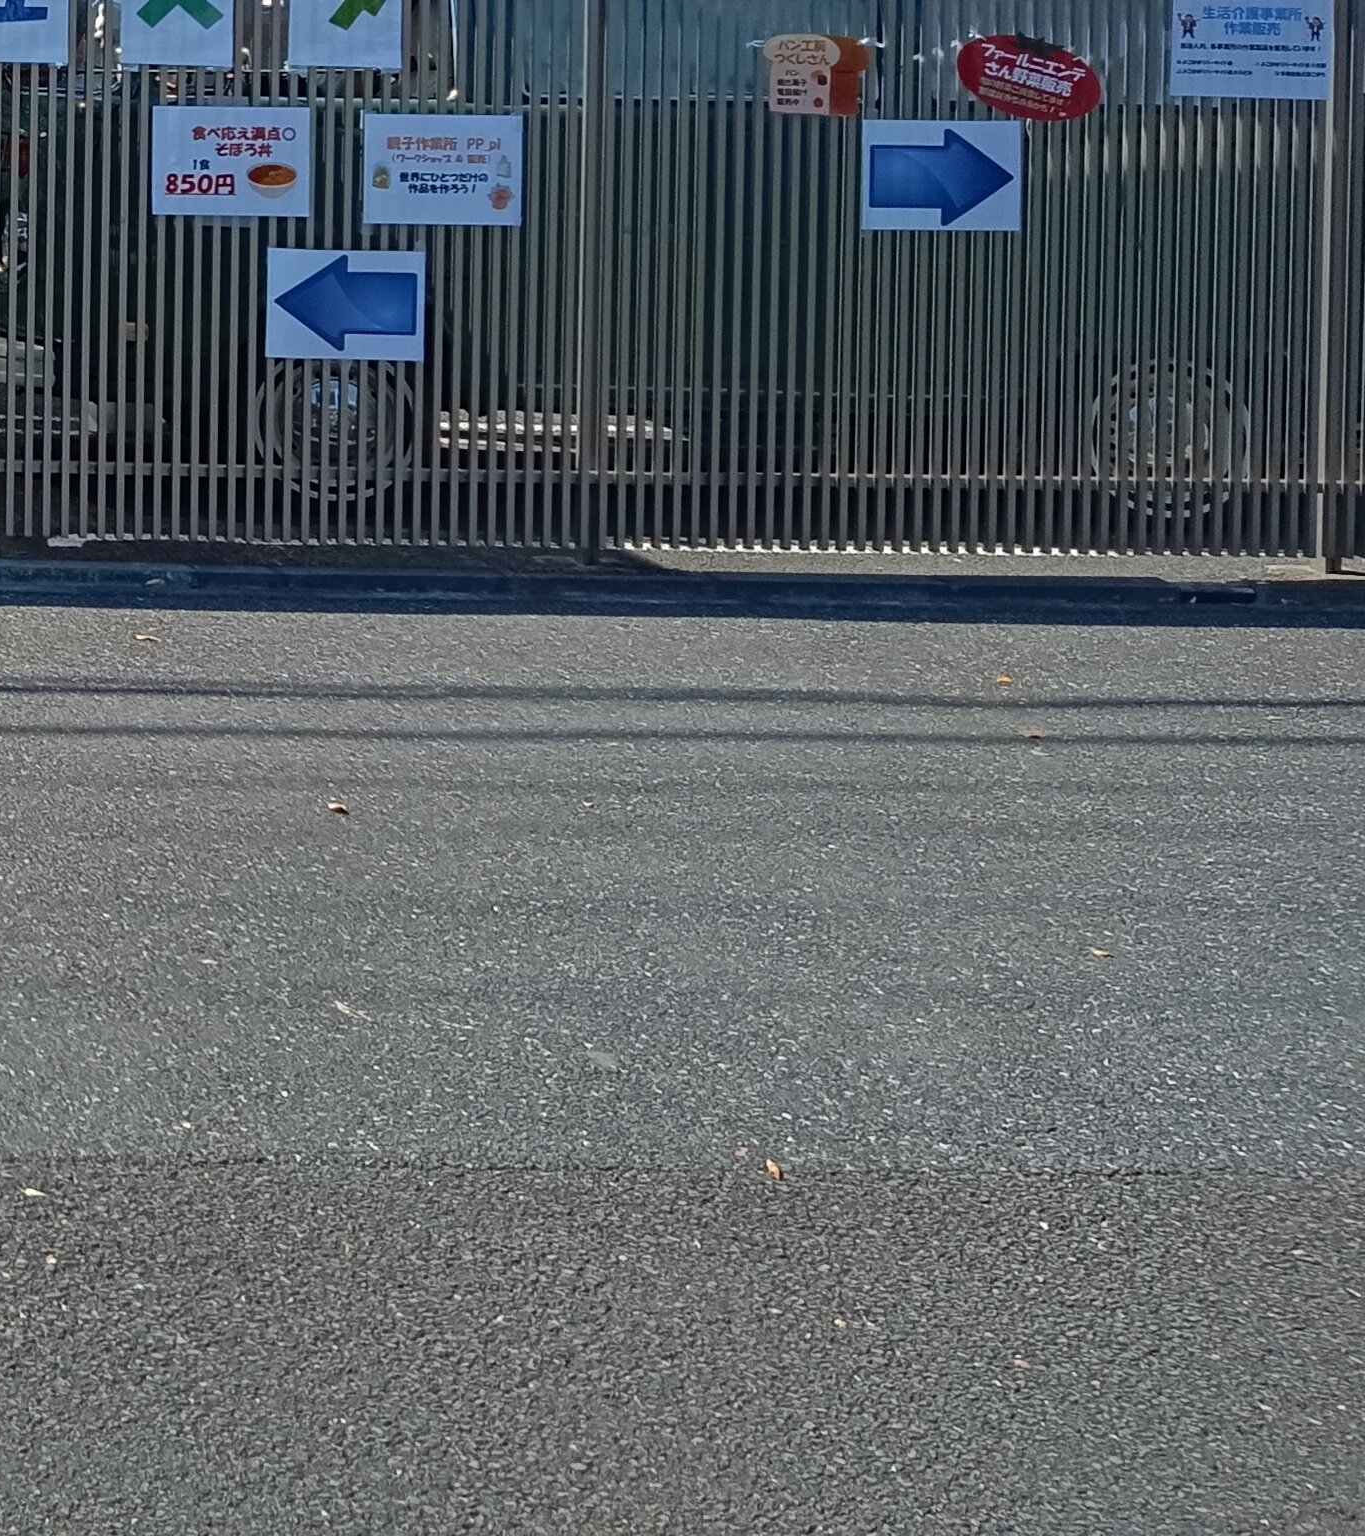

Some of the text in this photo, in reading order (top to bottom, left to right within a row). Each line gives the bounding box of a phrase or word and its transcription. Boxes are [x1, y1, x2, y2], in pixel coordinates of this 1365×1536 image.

[774, 54, 830, 65] つくしさん
[215, 143, 273, 157] そぼろ丼
[165, 173, 237, 195] 850円
